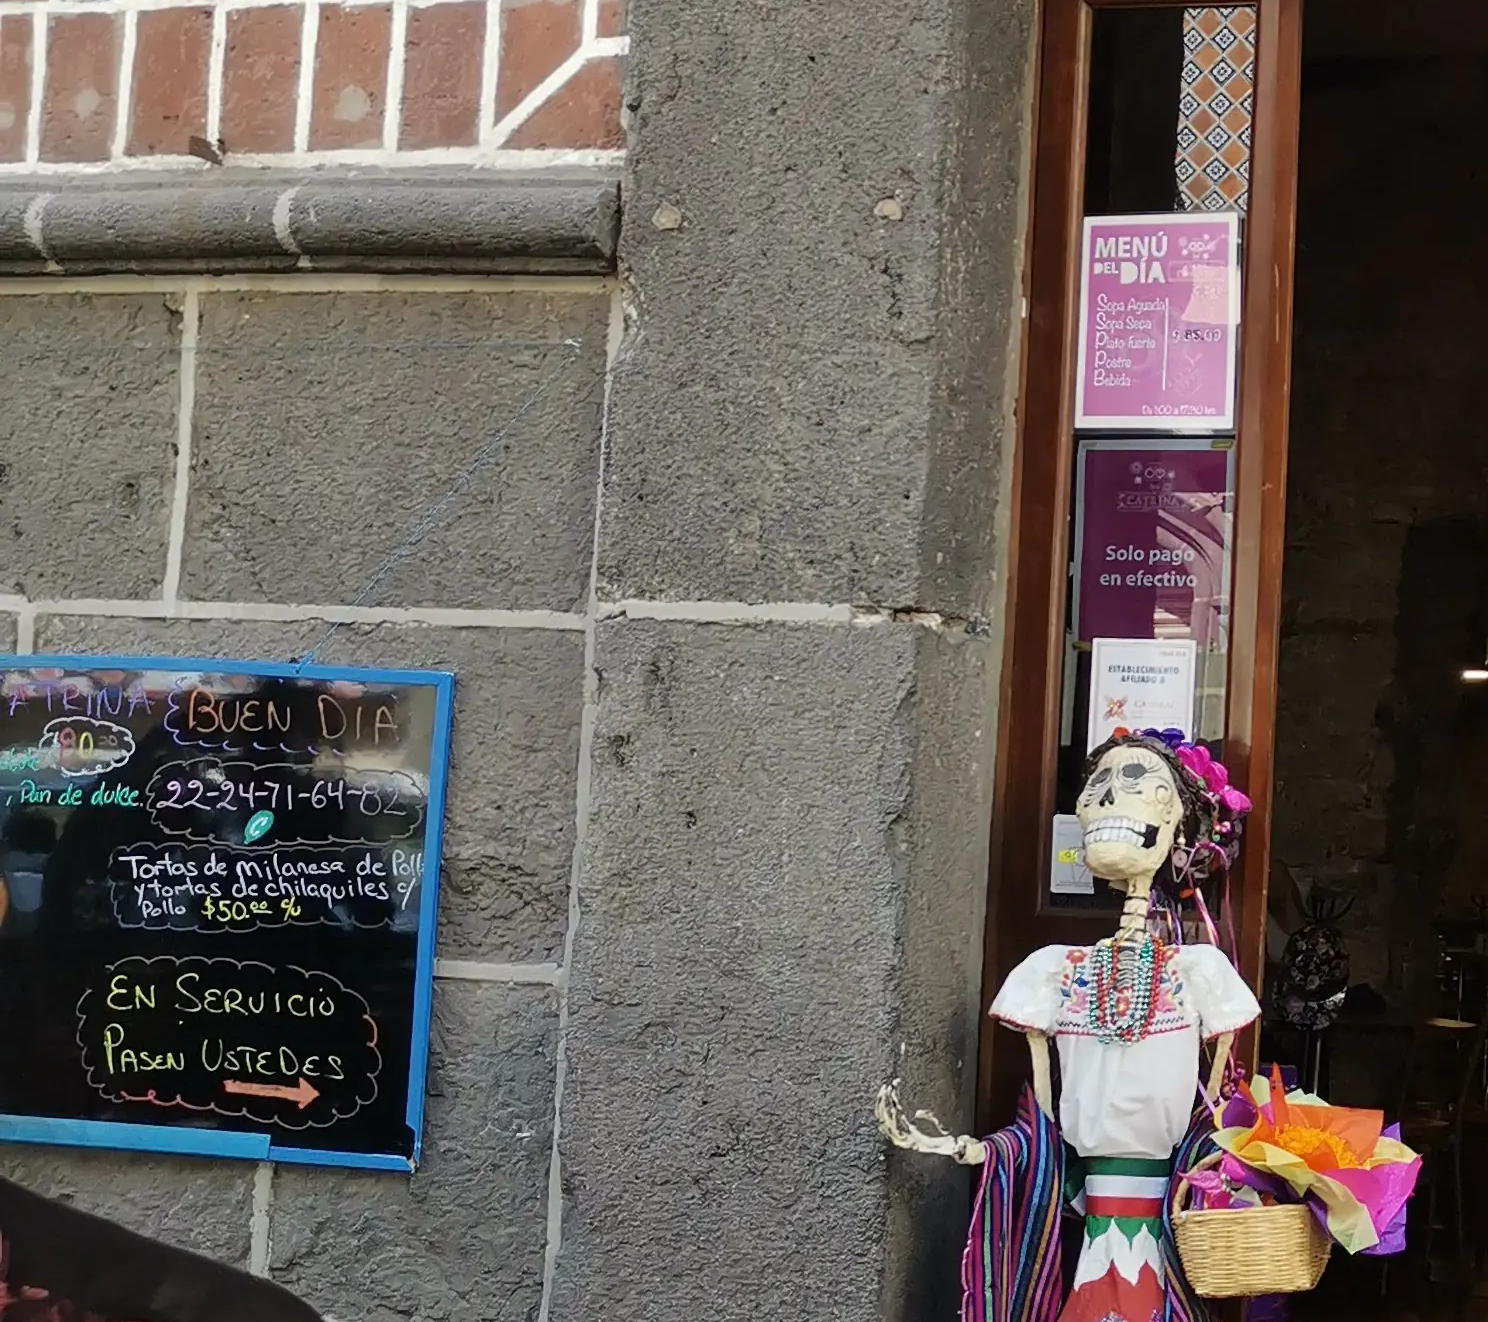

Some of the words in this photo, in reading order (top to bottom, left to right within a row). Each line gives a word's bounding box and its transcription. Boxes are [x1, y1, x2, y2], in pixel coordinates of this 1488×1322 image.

[1094, 231, 1168, 258] MENÚ
[1094, 262, 1118, 275] DEL
[1120, 258, 1166, 284] DÍA
[1097, 293, 1125, 315] Sopa
[1127, 297, 1165, 315] Aguada
[1096, 312, 1124, 334] Sopa
[1105, 545, 1145, 561] Solo
[1149, 548, 1195, 565] pago
[1100, 573, 1121, 586] en
[1126, 569, 1198, 587] efectivo
[6, 681, 154, 718] ATRINA
[188, 687, 291, 733] BUEN
[317, 694, 399, 745] DIA
[20, 780, 52, 804] Pan
[58, 782, 83, 805] de
[118, 854, 199, 879] Tortas
[203, 853, 228, 877] de
[235, 853, 345, 880] milanesa
[356, 853, 387, 876] de
[147, 878, 222, 898] tortas
[231, 879, 258, 898] de
[264, 877, 389, 908] chilaquiles
[397, 877, 416, 910] c/
[142, 899, 187, 918] Pollo
[106, 975, 155, 1010] EN
[104, 1023, 184, 1074] PASEN
[202, 1039, 345, 1079] USTEDES
